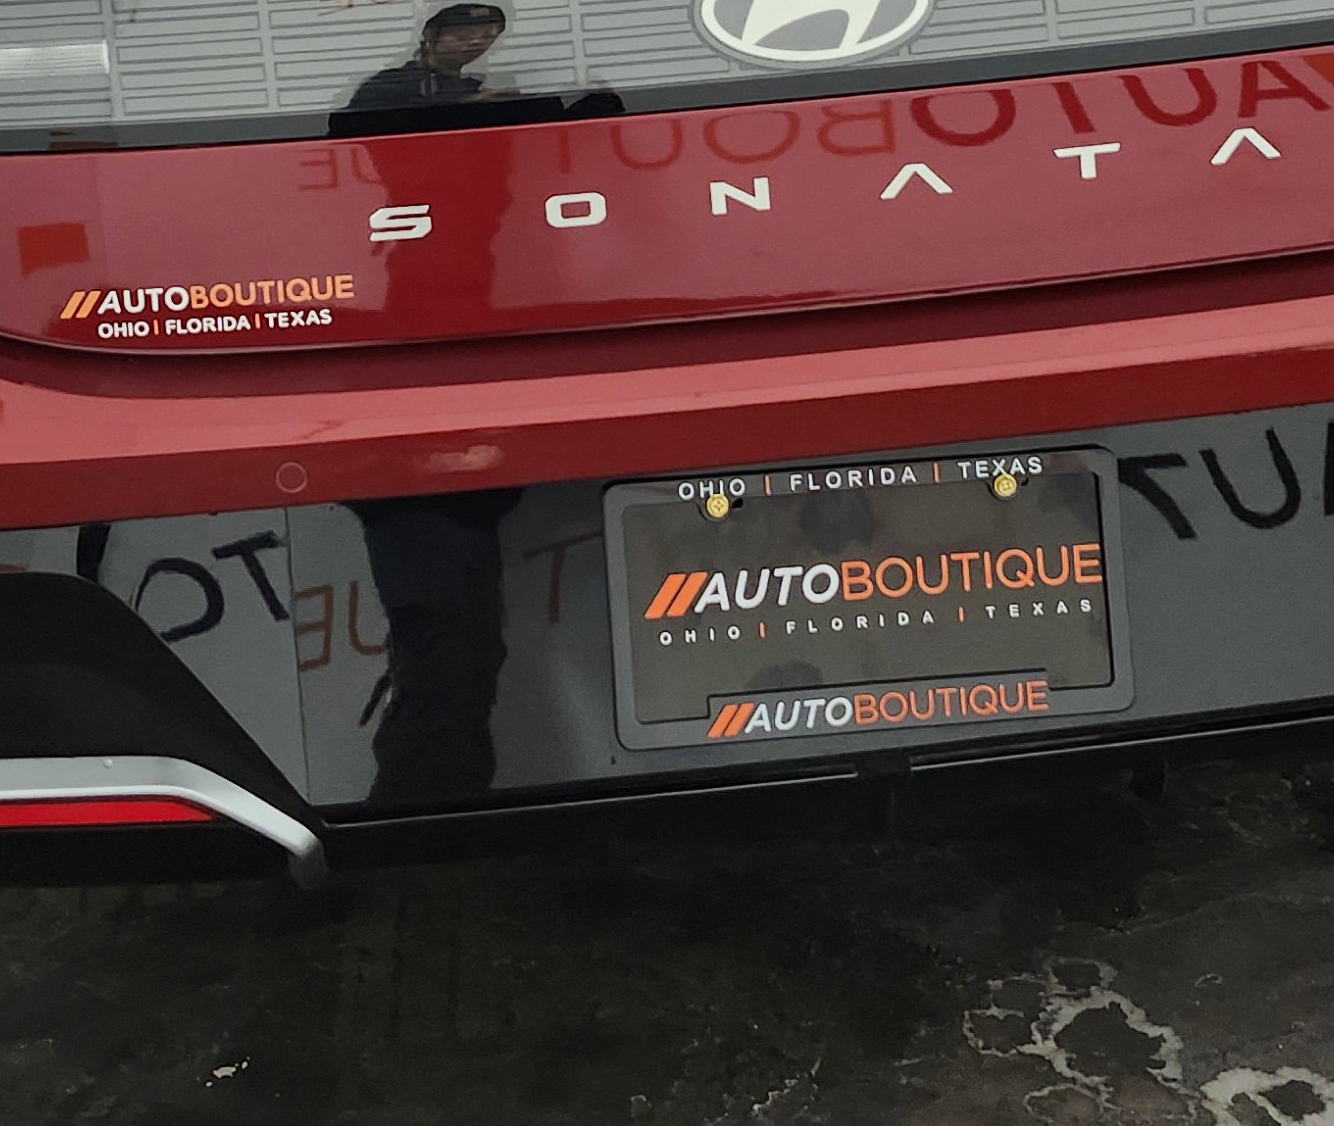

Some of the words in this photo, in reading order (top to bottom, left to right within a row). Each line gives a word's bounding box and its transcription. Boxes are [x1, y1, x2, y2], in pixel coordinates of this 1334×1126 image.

[368, 127, 1281, 242] SONATA
[97, 274, 355, 315] AUTOBOUTIQUE
[97, 320, 150, 339] OHIO
[165, 315, 251, 336] FLORIDA
[264, 308, 333, 328] TEXAS
[678, 477, 747, 501] OHIO
[789, 465, 917, 492] FLORIDA
[957, 455, 1044, 481] TEXAS
[694, 542, 1104, 614] AUTOBOUTIQUE
[658, 624, 743, 647] OHIO
[785, 609, 936, 635] FLORIDA
[985, 597, 1093, 620] TEXAS
[744, 680, 1050, 735] AUTOBOUTIQUE
